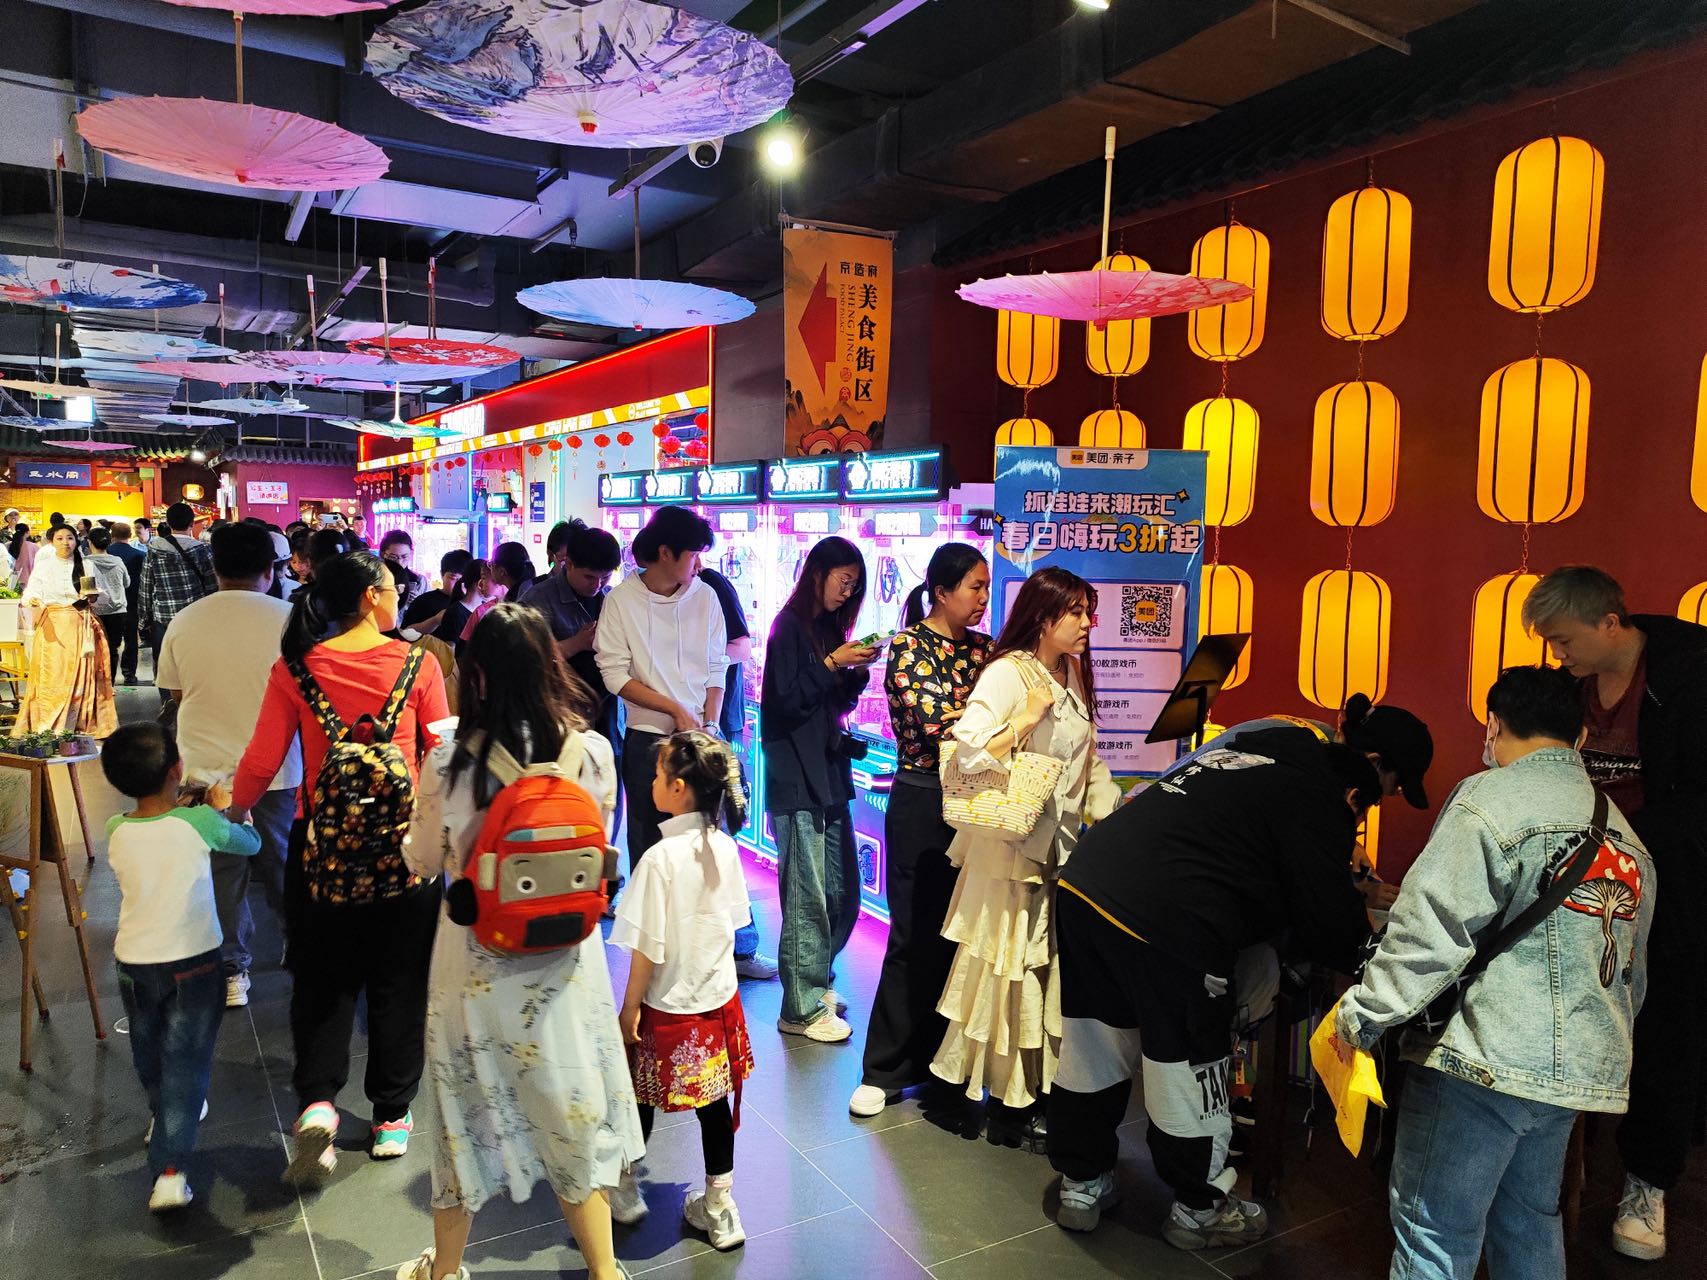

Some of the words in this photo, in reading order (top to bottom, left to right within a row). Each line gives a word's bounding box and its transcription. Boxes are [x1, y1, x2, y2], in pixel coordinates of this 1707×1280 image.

[847, 284, 856, 329] SHENG
[846, 332, 855, 363] JING
[854, 283, 878, 402] 美食街区
[1024, 491, 1176, 516] 抓娃娃来潮玩汇
[1001, 522, 1200, 554] 春日嗨玩3折起
[1138, 607, 1155, 616] 美团
